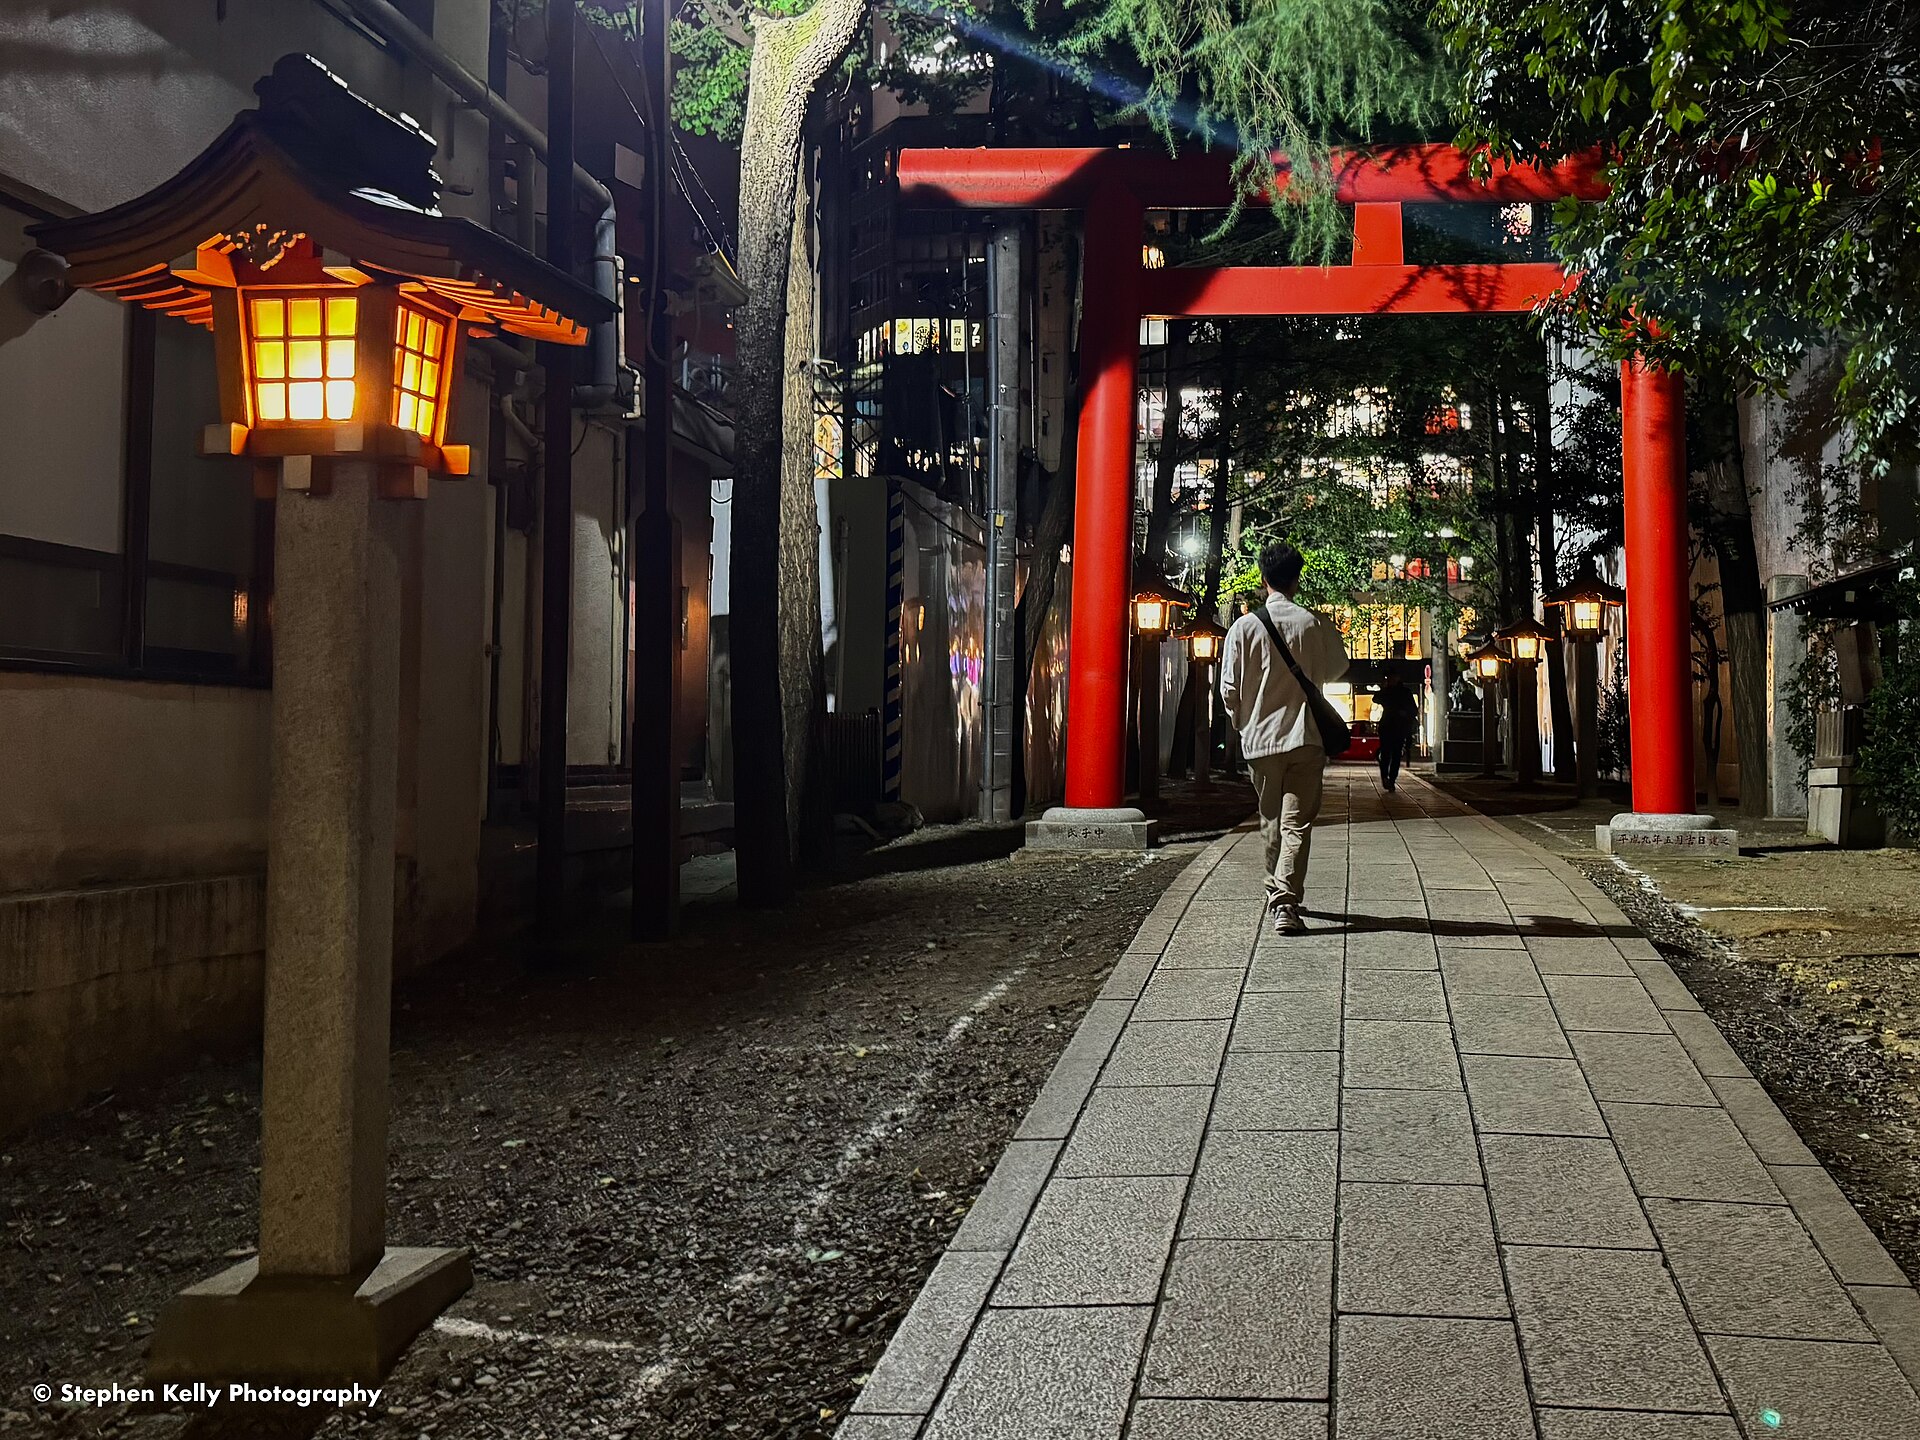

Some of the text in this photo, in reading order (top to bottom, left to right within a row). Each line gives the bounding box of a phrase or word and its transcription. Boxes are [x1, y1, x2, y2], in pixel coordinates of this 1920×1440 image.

[971, 322, 981, 348] 7F
[1067, 827, 1105, 839] 氏子中
